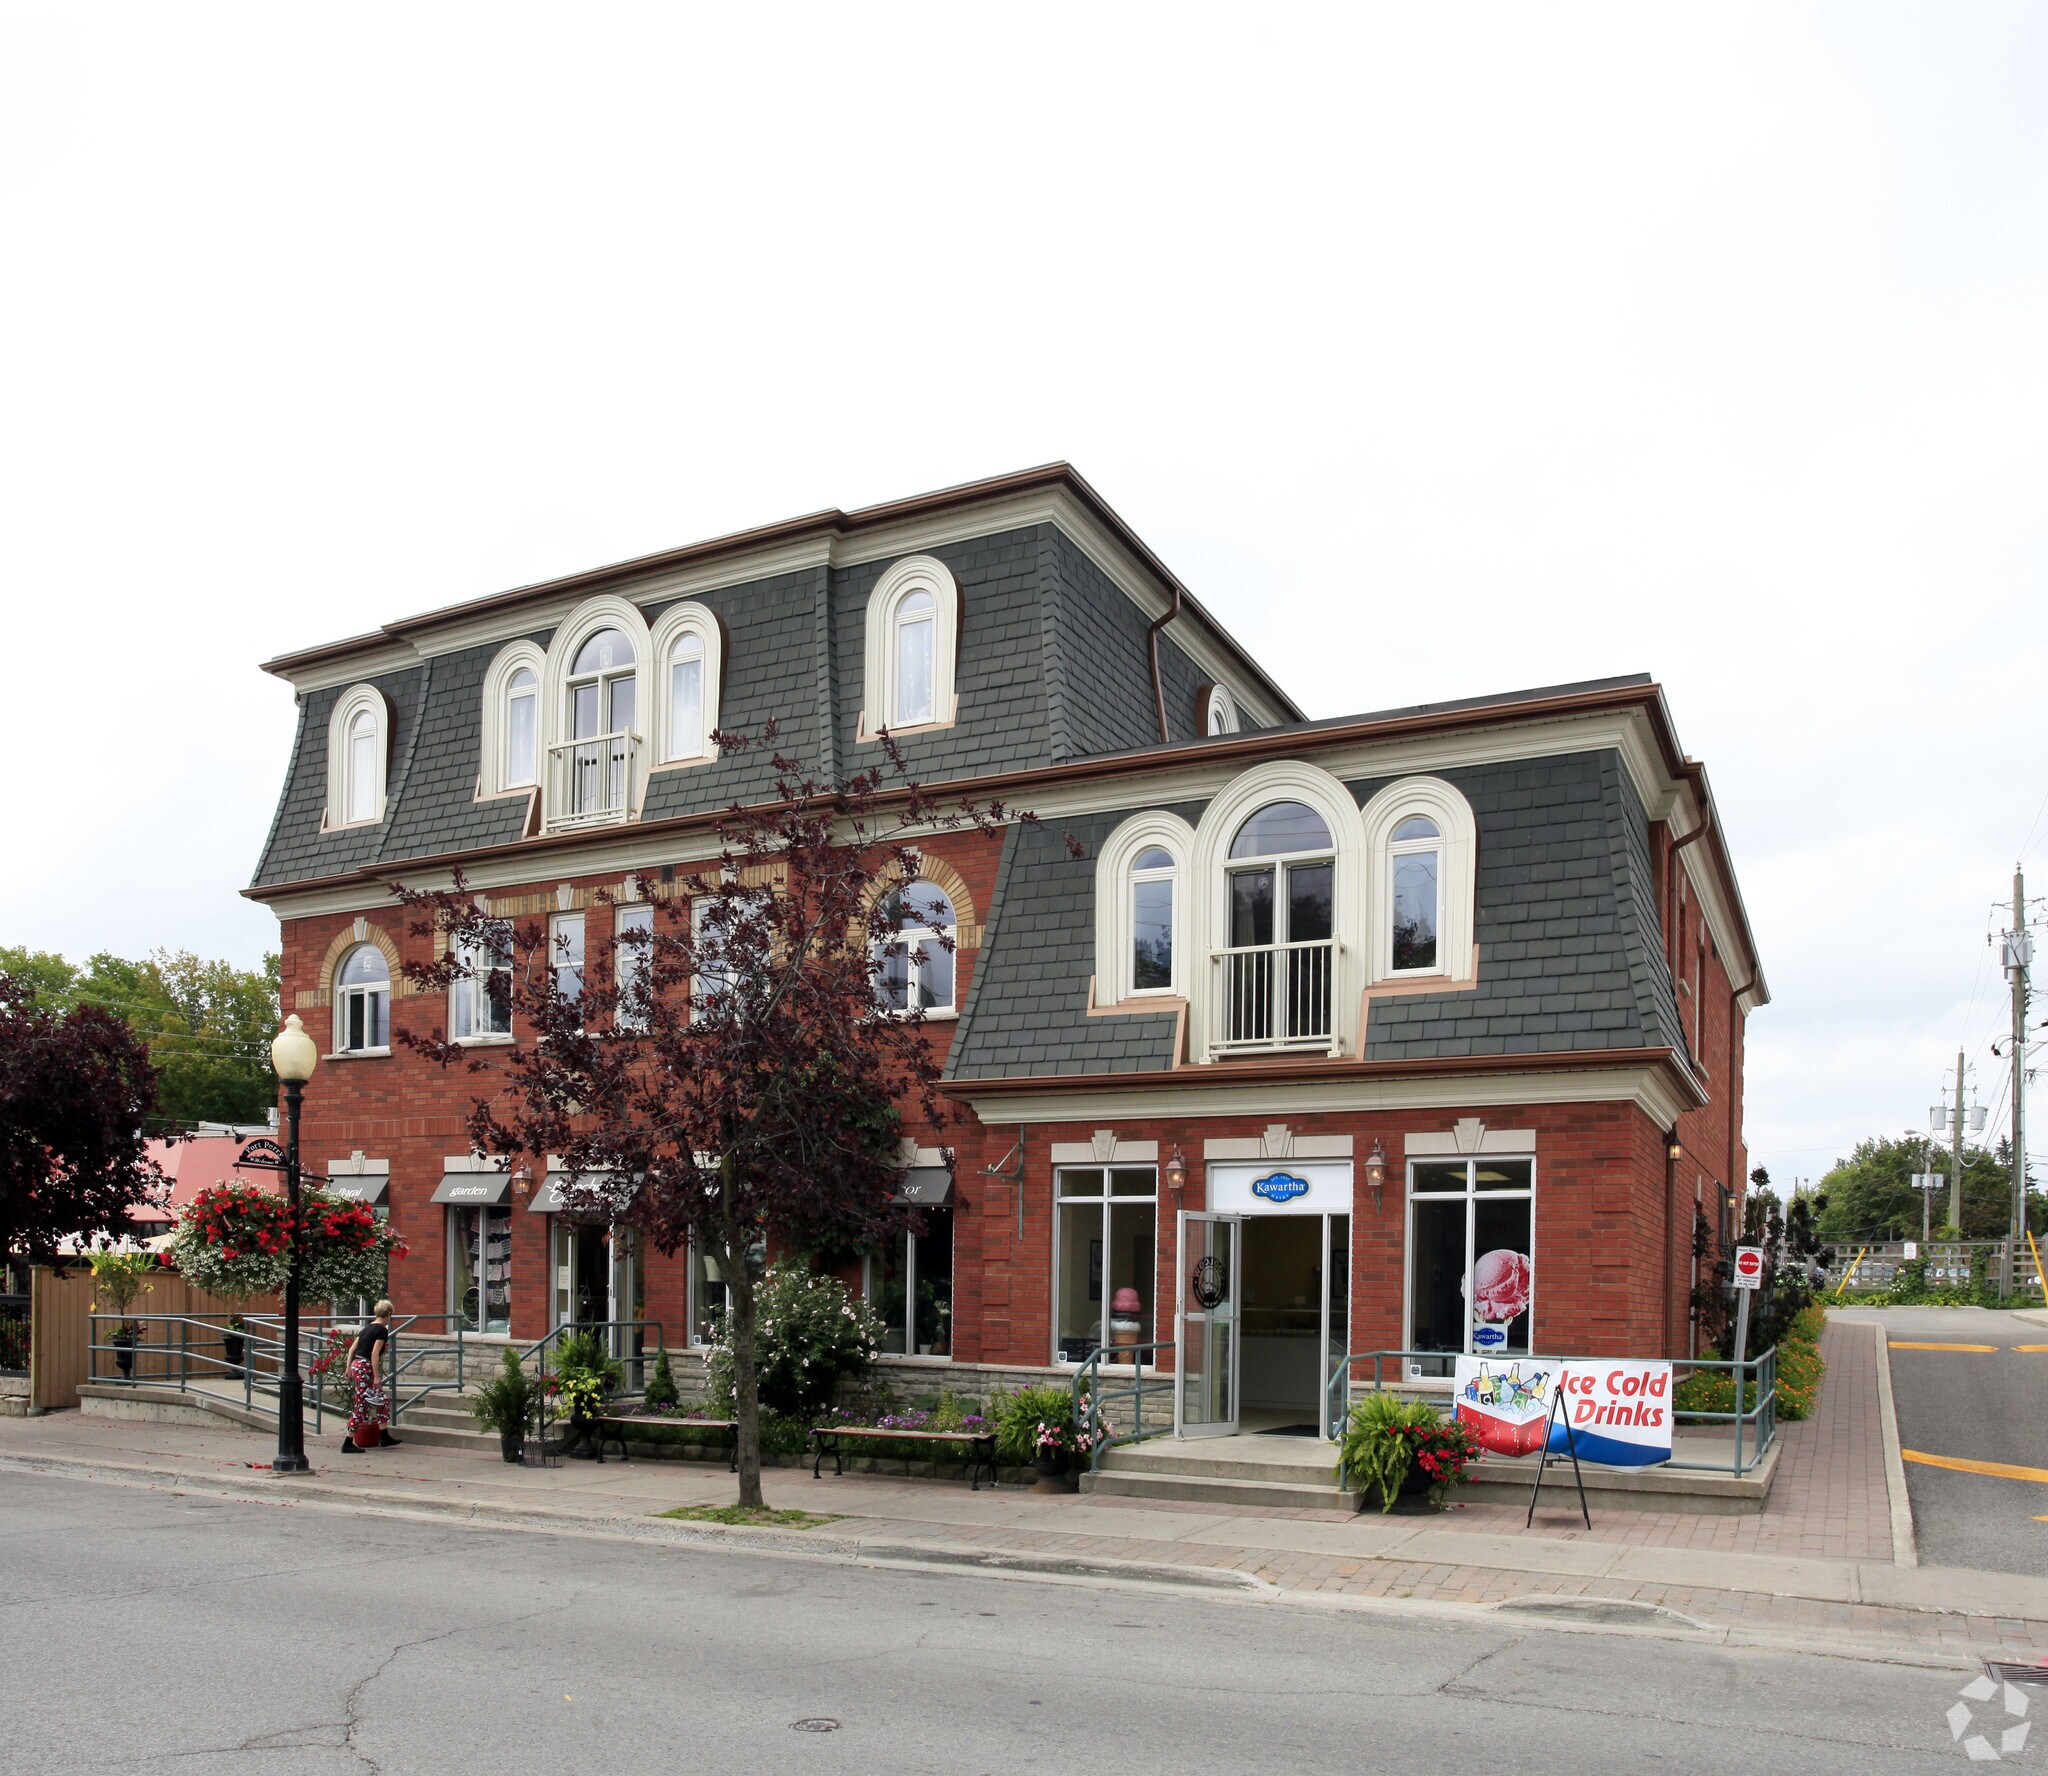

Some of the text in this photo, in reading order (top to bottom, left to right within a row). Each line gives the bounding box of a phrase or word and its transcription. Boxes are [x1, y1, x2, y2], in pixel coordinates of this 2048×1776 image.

[245, 1141, 284, 1157] Port Perry
[338, 1187, 363, 1197] floral
[449, 1186, 488, 1197] garden
[1256, 1182, 1304, 1194] Kawartha
[1560, 1370, 1668, 1397] Ice Cold
[1574, 1399, 1664, 1426] Drinks
